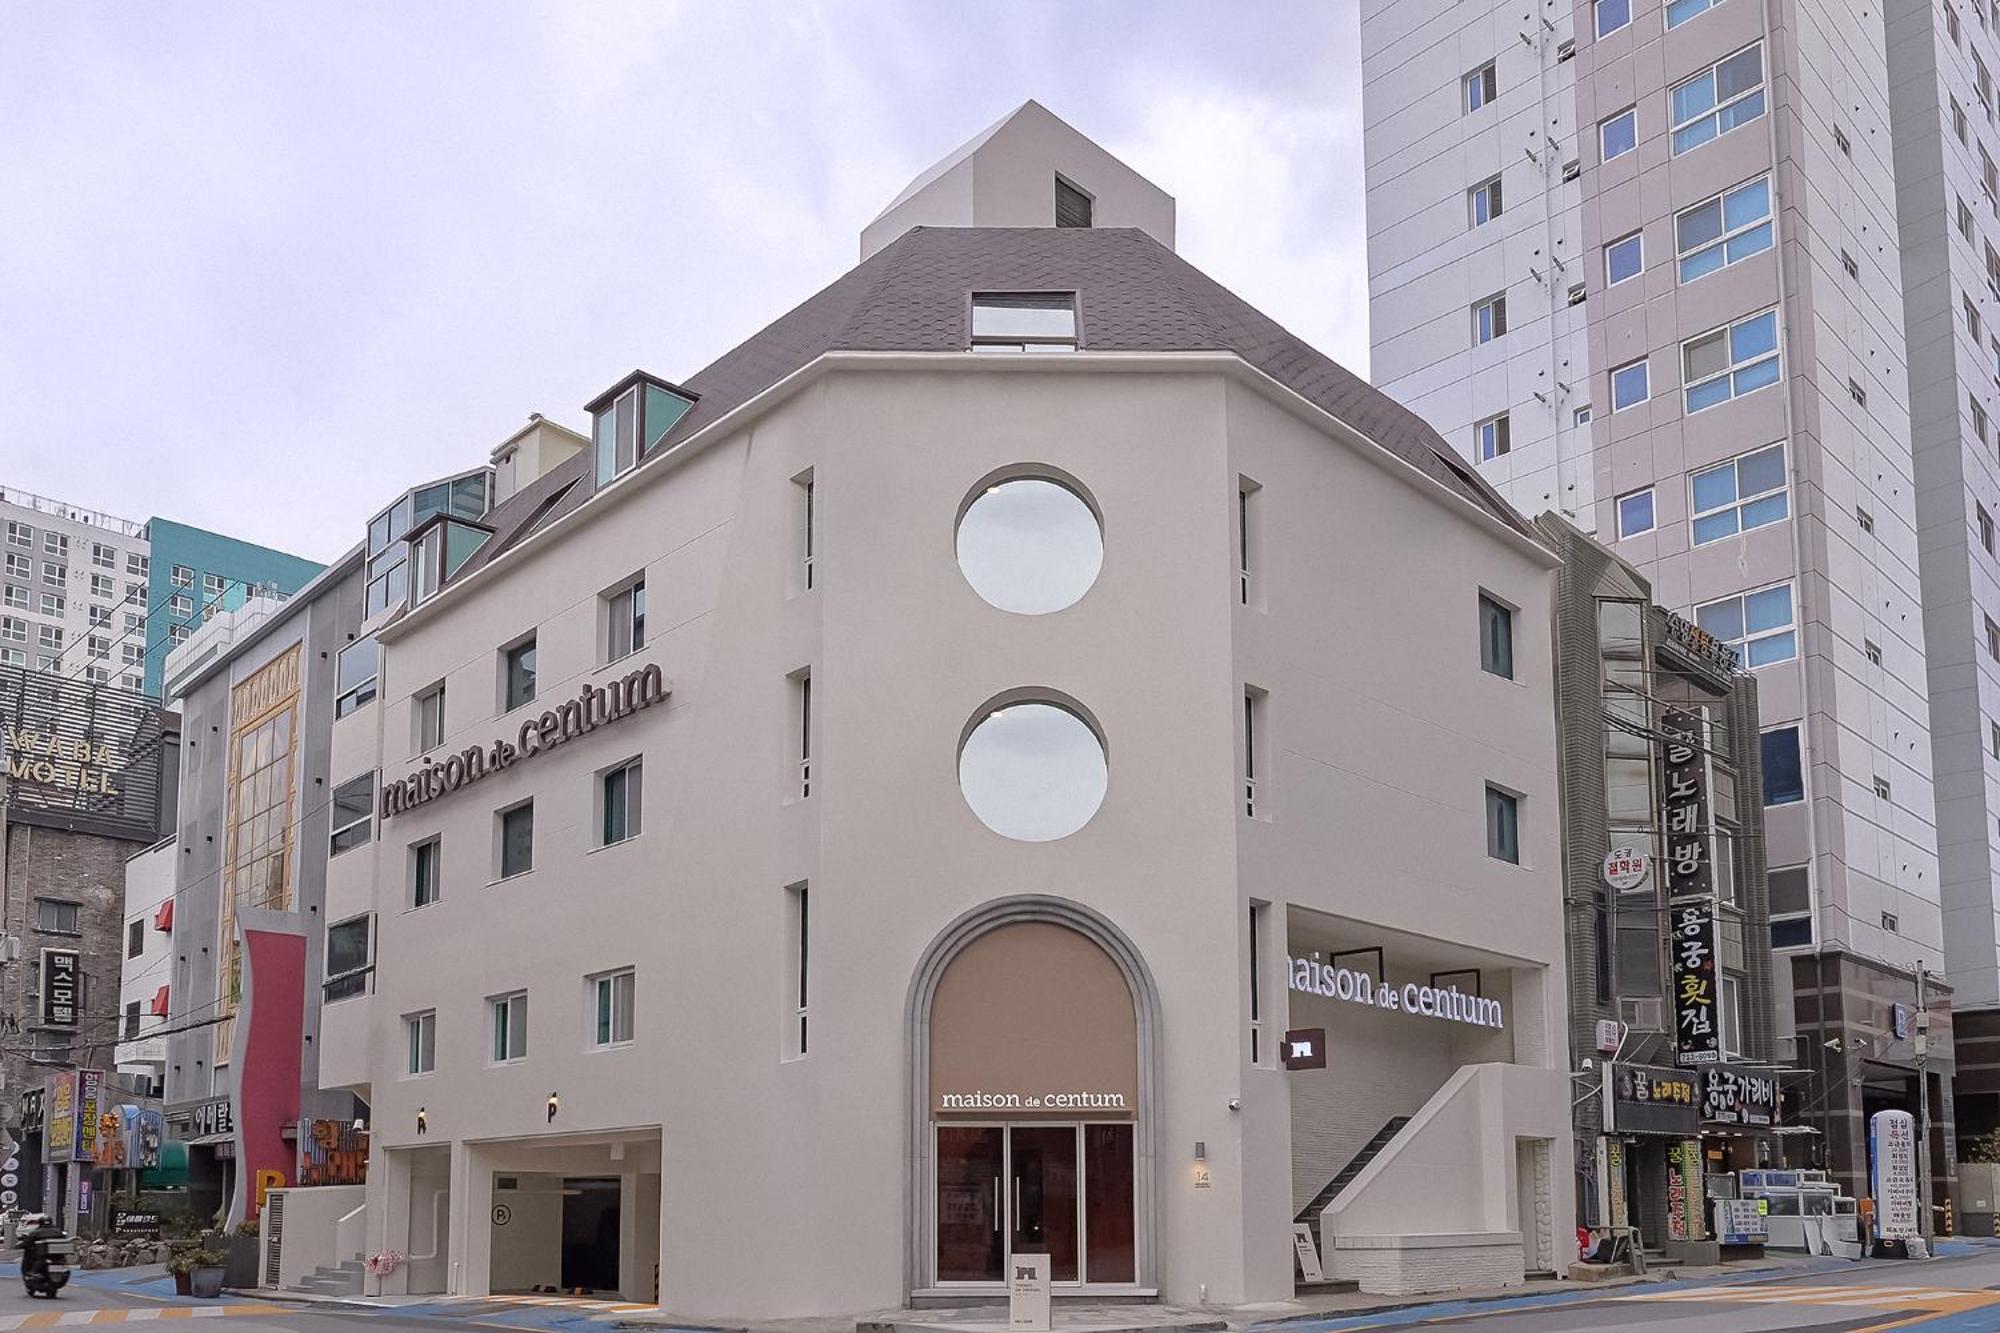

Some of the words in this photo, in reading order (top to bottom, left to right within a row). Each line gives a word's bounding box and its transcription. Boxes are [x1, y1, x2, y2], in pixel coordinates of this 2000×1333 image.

[380, 745, 485, 820] maison
[488, 739, 516, 771] de
[518, 662, 671, 758] centum
[5, 755, 119, 795] MOTEL
[53, 956, 73, 1022] 맥스모텔
[1678, 908, 1712, 1035] 용궁횟집
[1378, 982, 1399, 1010] de
[1401, 982, 1503, 1029] centum
[942, 1090, 1020, 1108] maison
[1024, 1096, 1041, 1108] de
[1043, 1091, 1125, 1107] centum
